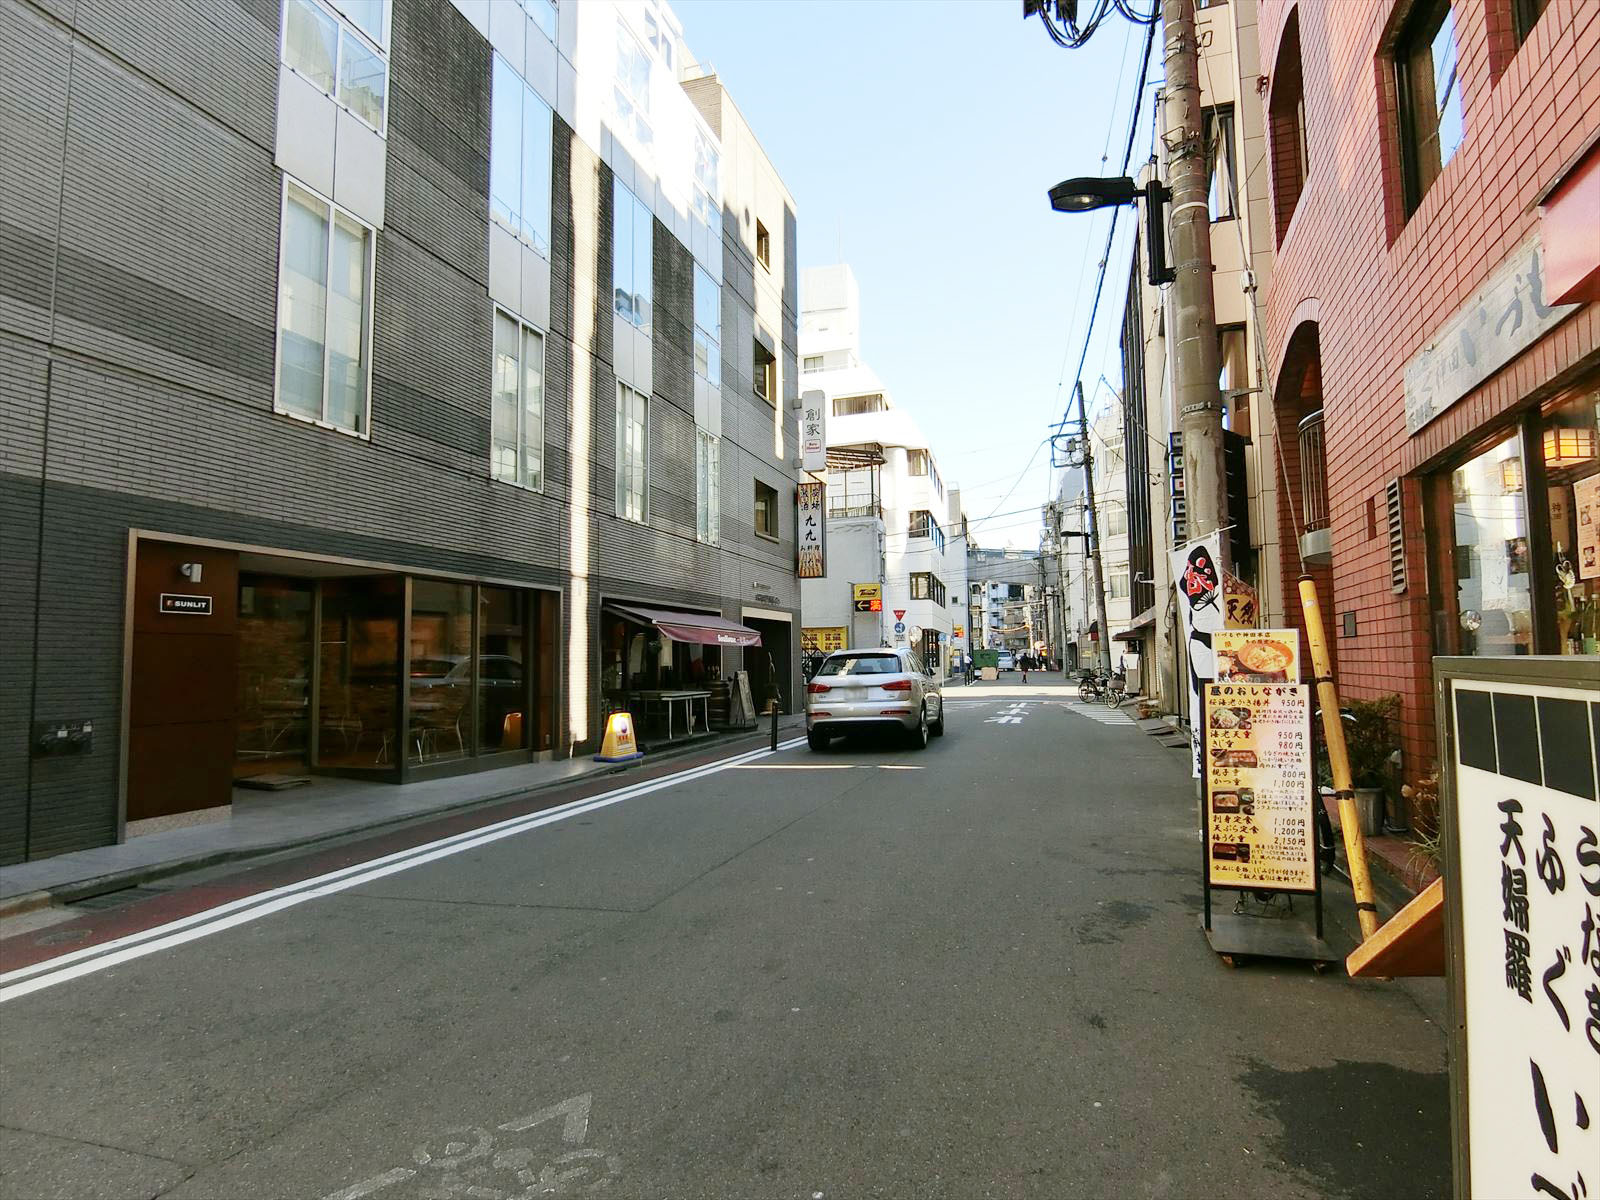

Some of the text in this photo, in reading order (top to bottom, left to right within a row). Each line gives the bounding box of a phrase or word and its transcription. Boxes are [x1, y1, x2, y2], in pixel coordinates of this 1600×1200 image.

[174, 600, 207, 609] SUNLIT
[1210, 686, 1298, 697] 昼のおしながき
[1281, 699, 1306, 708] 950円
[1277, 731, 1304, 740] 950円
[1278, 741, 1304, 750] 980円
[1282, 770, 1307, 779] 800円
[1273, 779, 1306, 789] 1,100円
[1274, 818, 1306, 827] 1,100円
[1213, 824, 1306, 837] 天ぷら定食 1,200円
[1274, 837, 1307, 846] 2,150円
[1497, 798, 1534, 1005] 天婦羅
